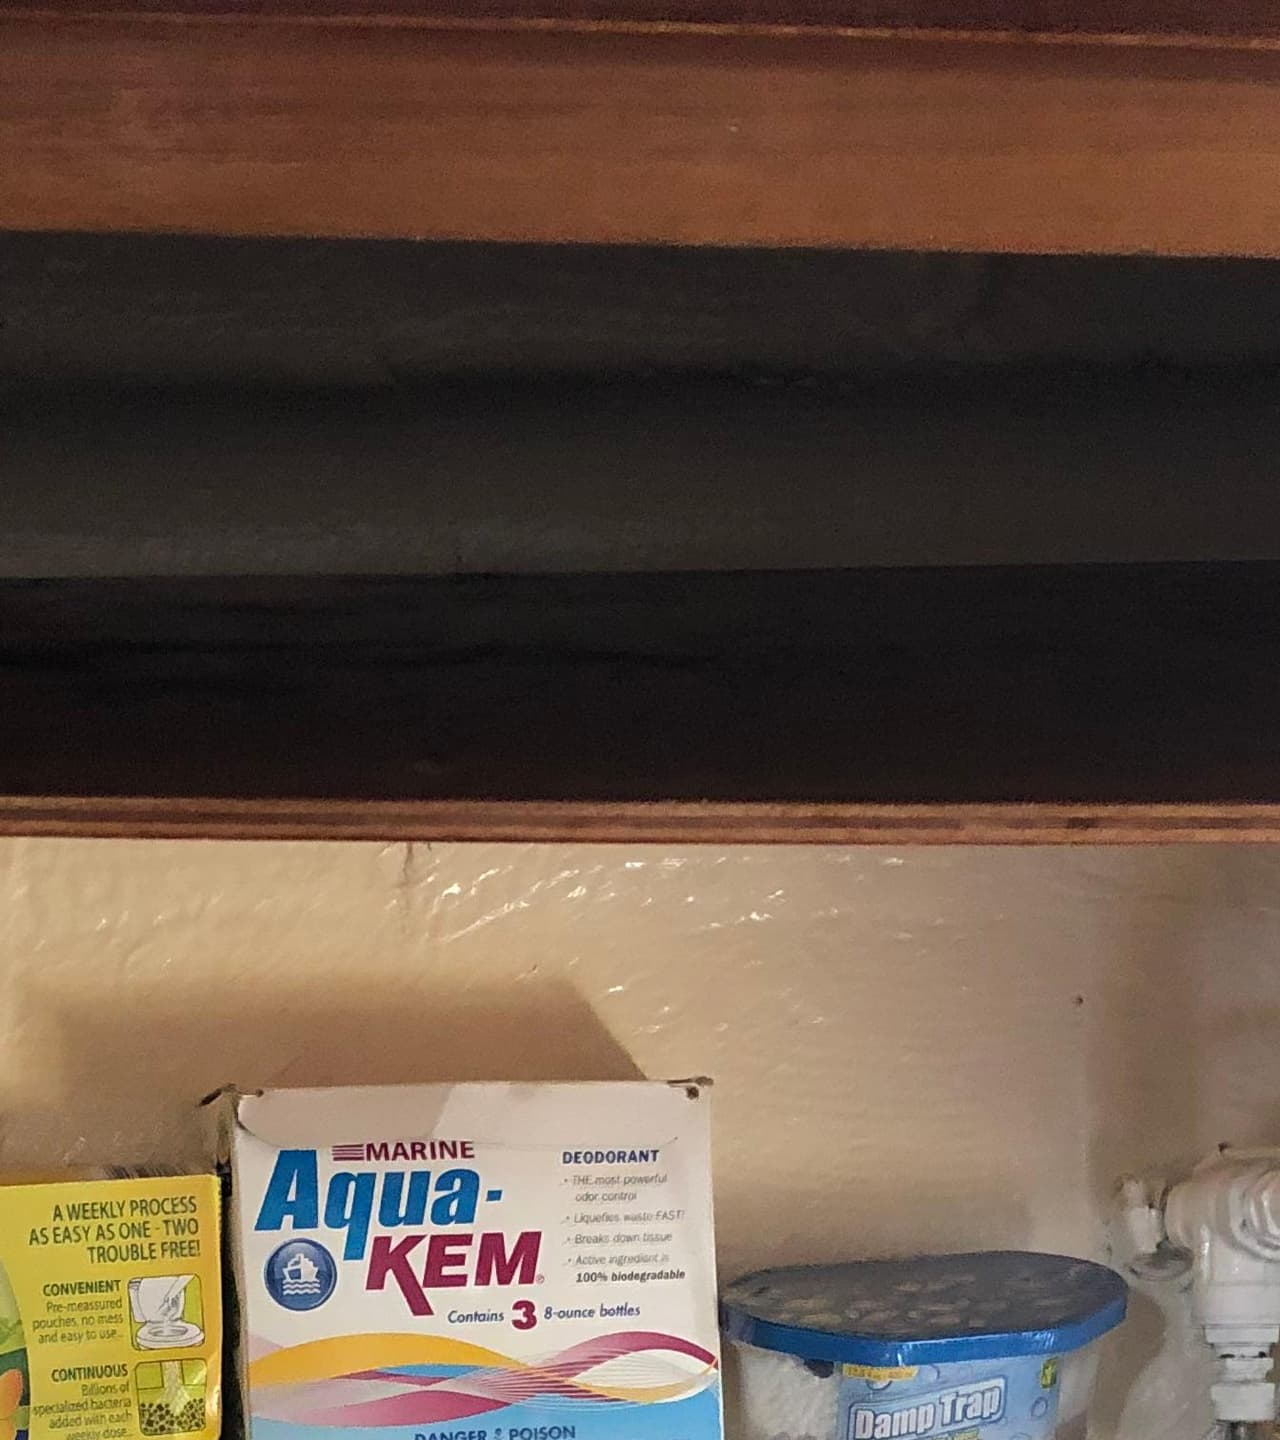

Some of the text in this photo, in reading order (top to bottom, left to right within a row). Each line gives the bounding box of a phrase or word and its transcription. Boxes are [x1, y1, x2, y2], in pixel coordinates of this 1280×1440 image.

[365, 1141, 476, 1161] MARINE
[562, 1150, 660, 1164] DEODORANT
[573, 1174, 668, 1185] THE most powerful
[254, 1150, 503, 1261] Aqua-
[575, 1192, 638, 1202] odor control
[53, 1196, 197, 1221] A WEEKLY PROCESS
[574, 1214, 620, 1224] Liquefies
[28, 1229, 49, 1246] AS
[52, 1225, 91, 1245] EASY
[95, 1223, 116, 1242] AS
[118, 1221, 152, 1240] ONE
[162, 1218, 200, 1237] TWO
[613, 1233, 641, 1243] down
[643, 1232, 673, 1242] tissue
[87, 1239, 201, 1264] TROUBLE FREE!
[576, 1269, 686, 1283] 100% biodegradable
[42, 1279, 122, 1297] CONVENIENT
[79, 1317, 95, 1328] no
[97, 1314, 124, 1326] mess
[447, 1300, 641, 1330] Contains 3 8-ounce bottles
[38, 1330, 59, 1344] and
[60, 1330, 83, 1344] easy
[85, 1328, 97, 1340] to
[51, 1363, 128, 1383] CONTINUOUS
[81, 1381, 130, 1396] Billions of
[33, 1396, 132, 1416] specialized bacteria
[853, 1385, 1002, 1440] Damp Trap
[49, 1410, 133, 1429] added with each
